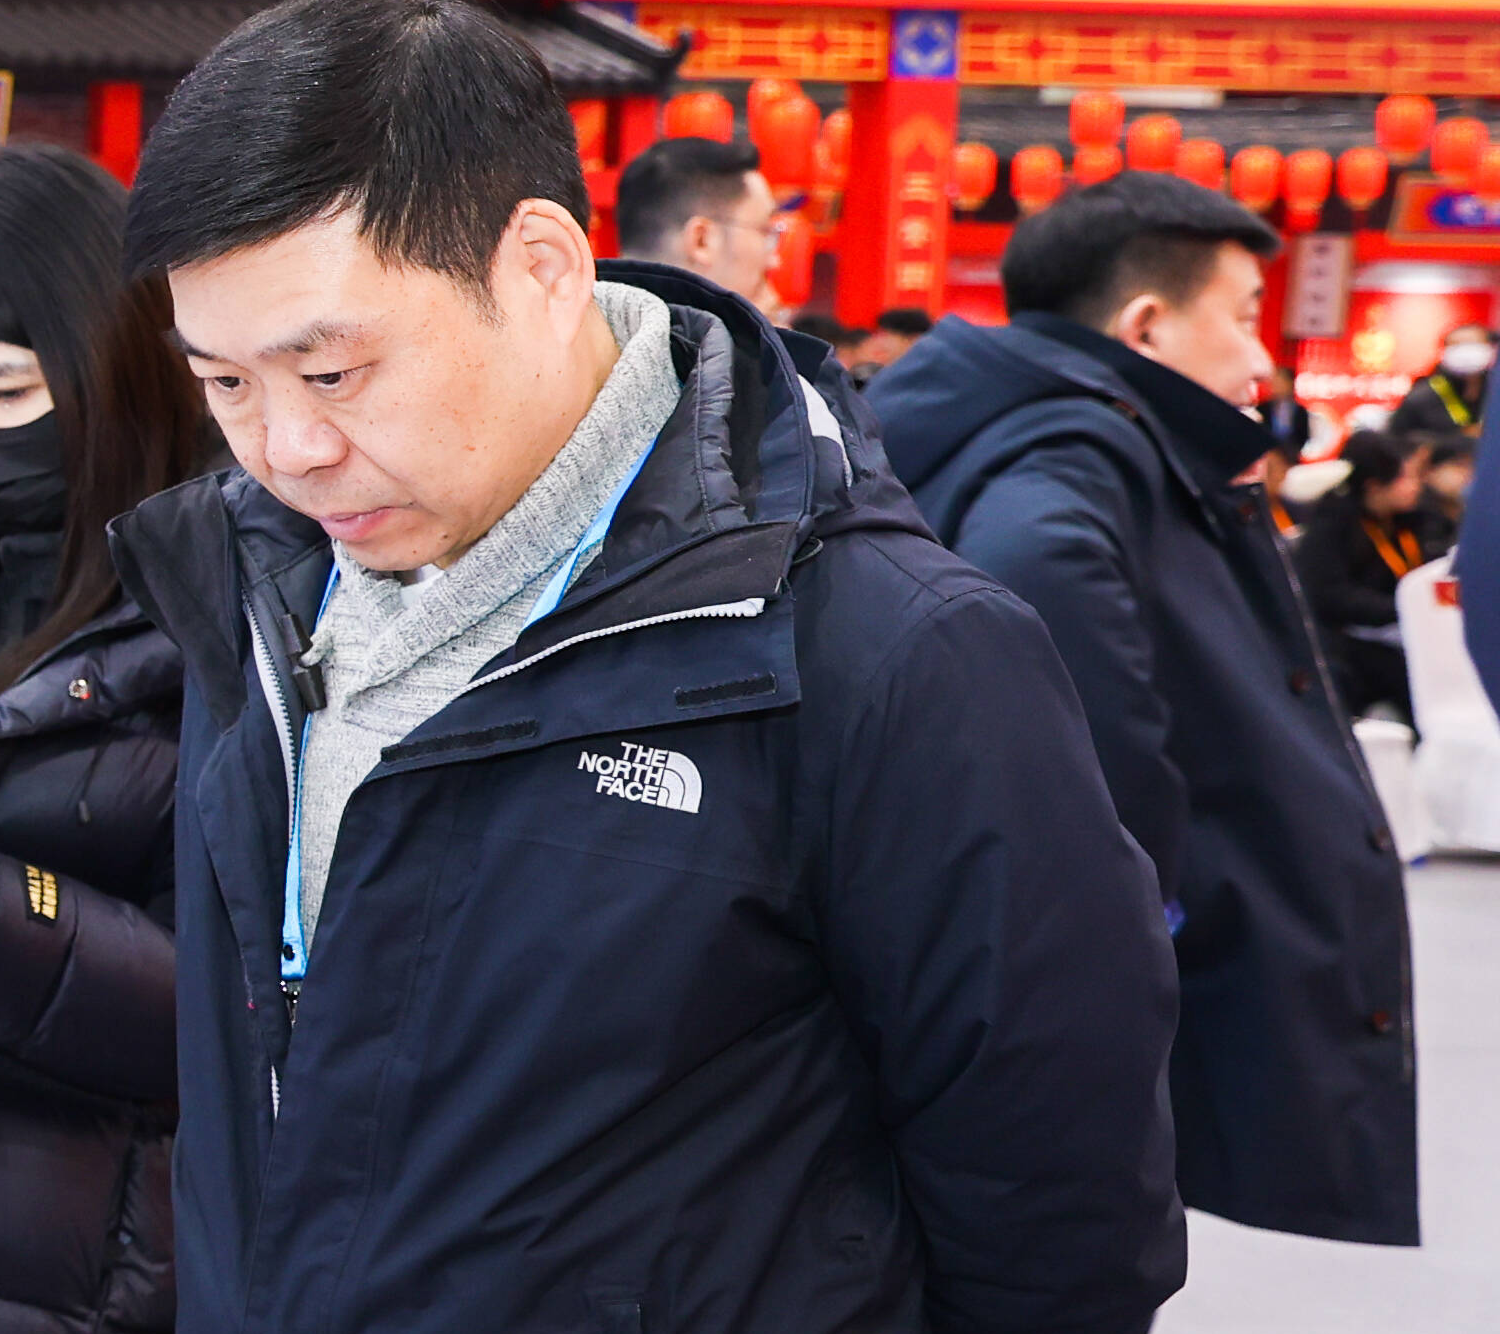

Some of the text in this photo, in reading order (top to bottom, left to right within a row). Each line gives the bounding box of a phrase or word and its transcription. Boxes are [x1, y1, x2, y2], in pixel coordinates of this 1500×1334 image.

[577, 751, 665, 786] NORTH
[620, 741, 669, 768] THE
[596, 776, 659, 805] FACE
